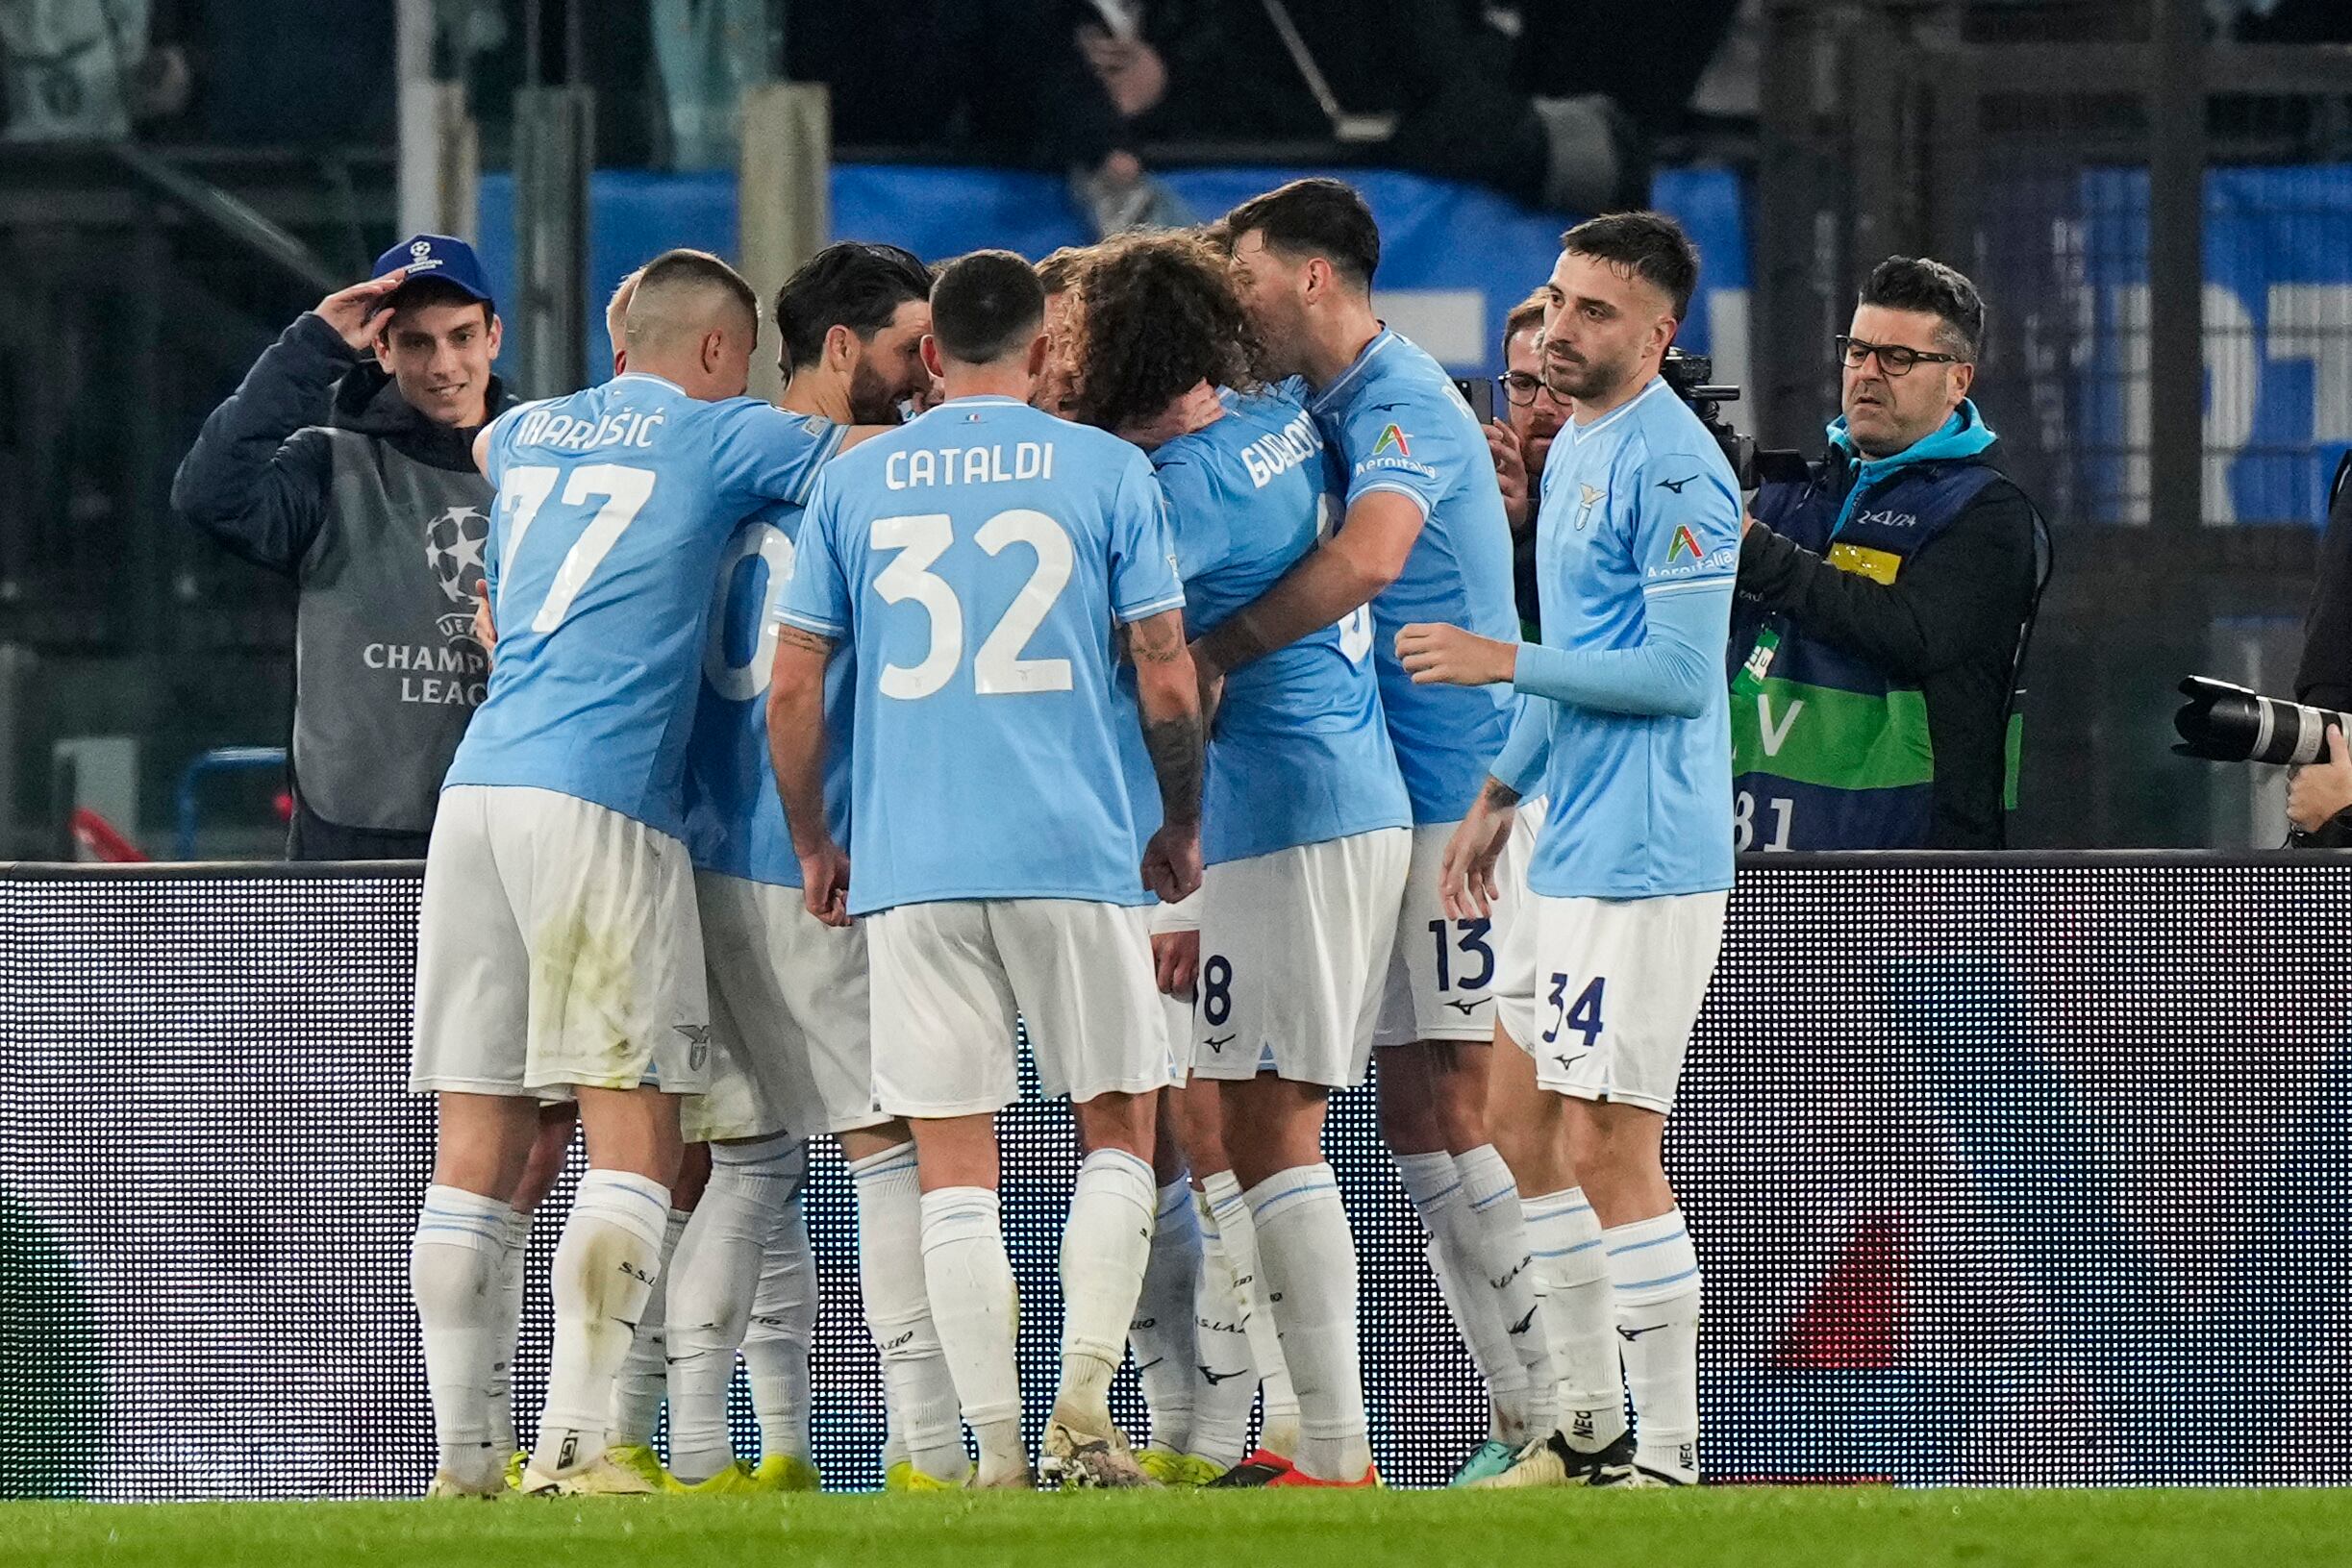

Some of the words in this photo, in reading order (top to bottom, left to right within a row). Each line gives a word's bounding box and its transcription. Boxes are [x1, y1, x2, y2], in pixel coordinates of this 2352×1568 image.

[886, 442, 1053, 490] CATALDI
[497, 464, 656, 634] 77
[870, 509, 1073, 700] 32
[1204, 955, 1232, 1026] 8
[1429, 917, 1494, 992] 13
[1542, 972, 1605, 1046] 34
